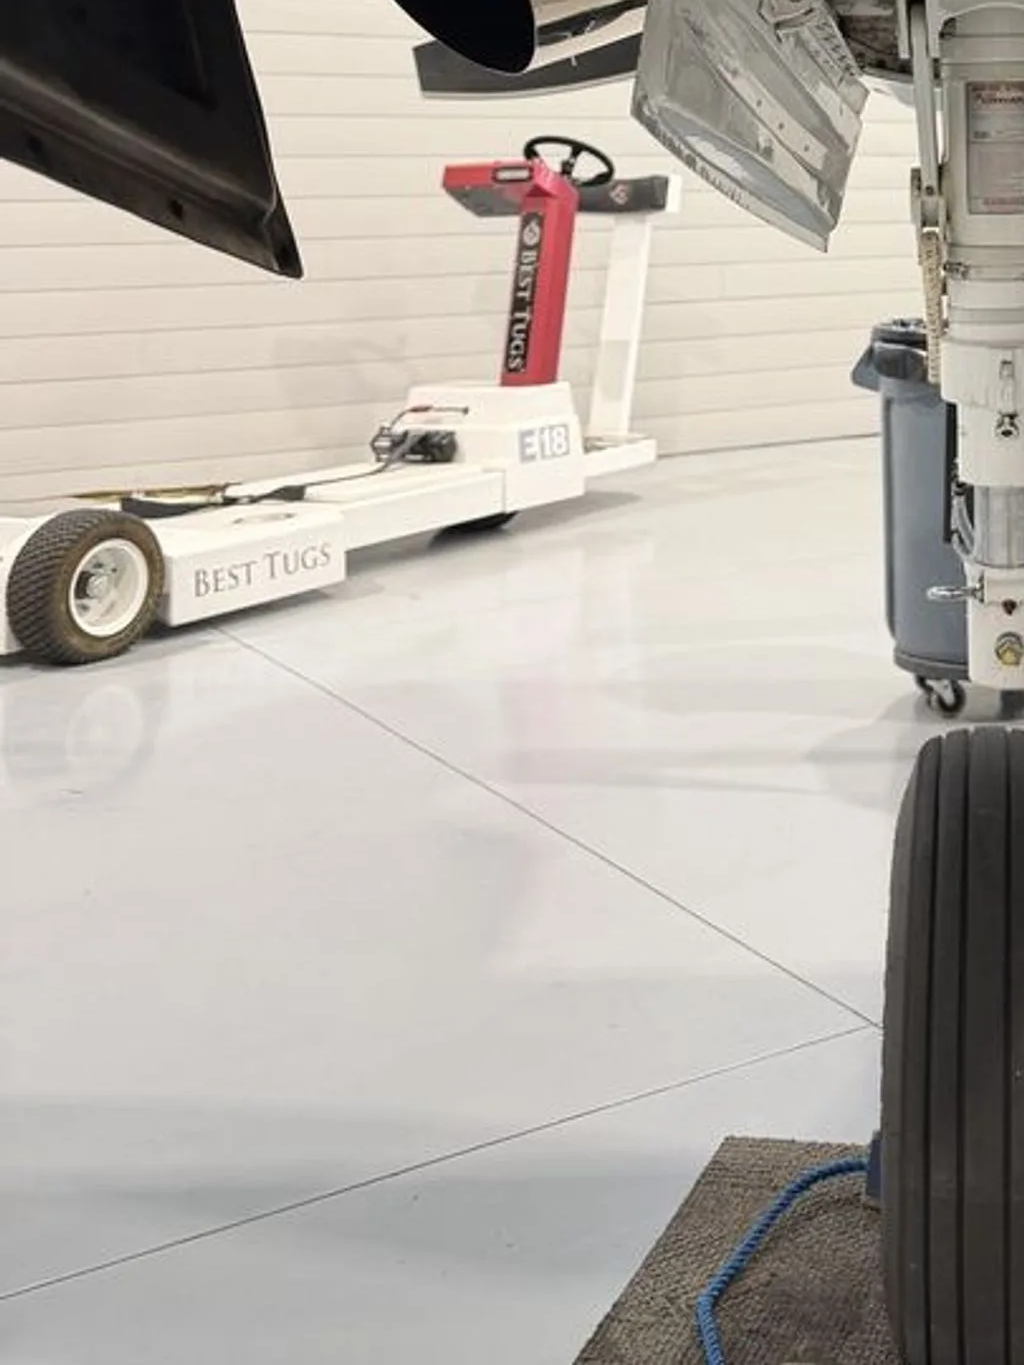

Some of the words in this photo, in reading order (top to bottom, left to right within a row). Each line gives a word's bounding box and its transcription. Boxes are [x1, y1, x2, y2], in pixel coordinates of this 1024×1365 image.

[516, 249, 537, 301] BEST
[508, 311, 532, 371] TUGS
[518, 423, 570, 464] E18
[193, 560, 258, 598] BEST
[263, 542, 332, 580] TUGS
